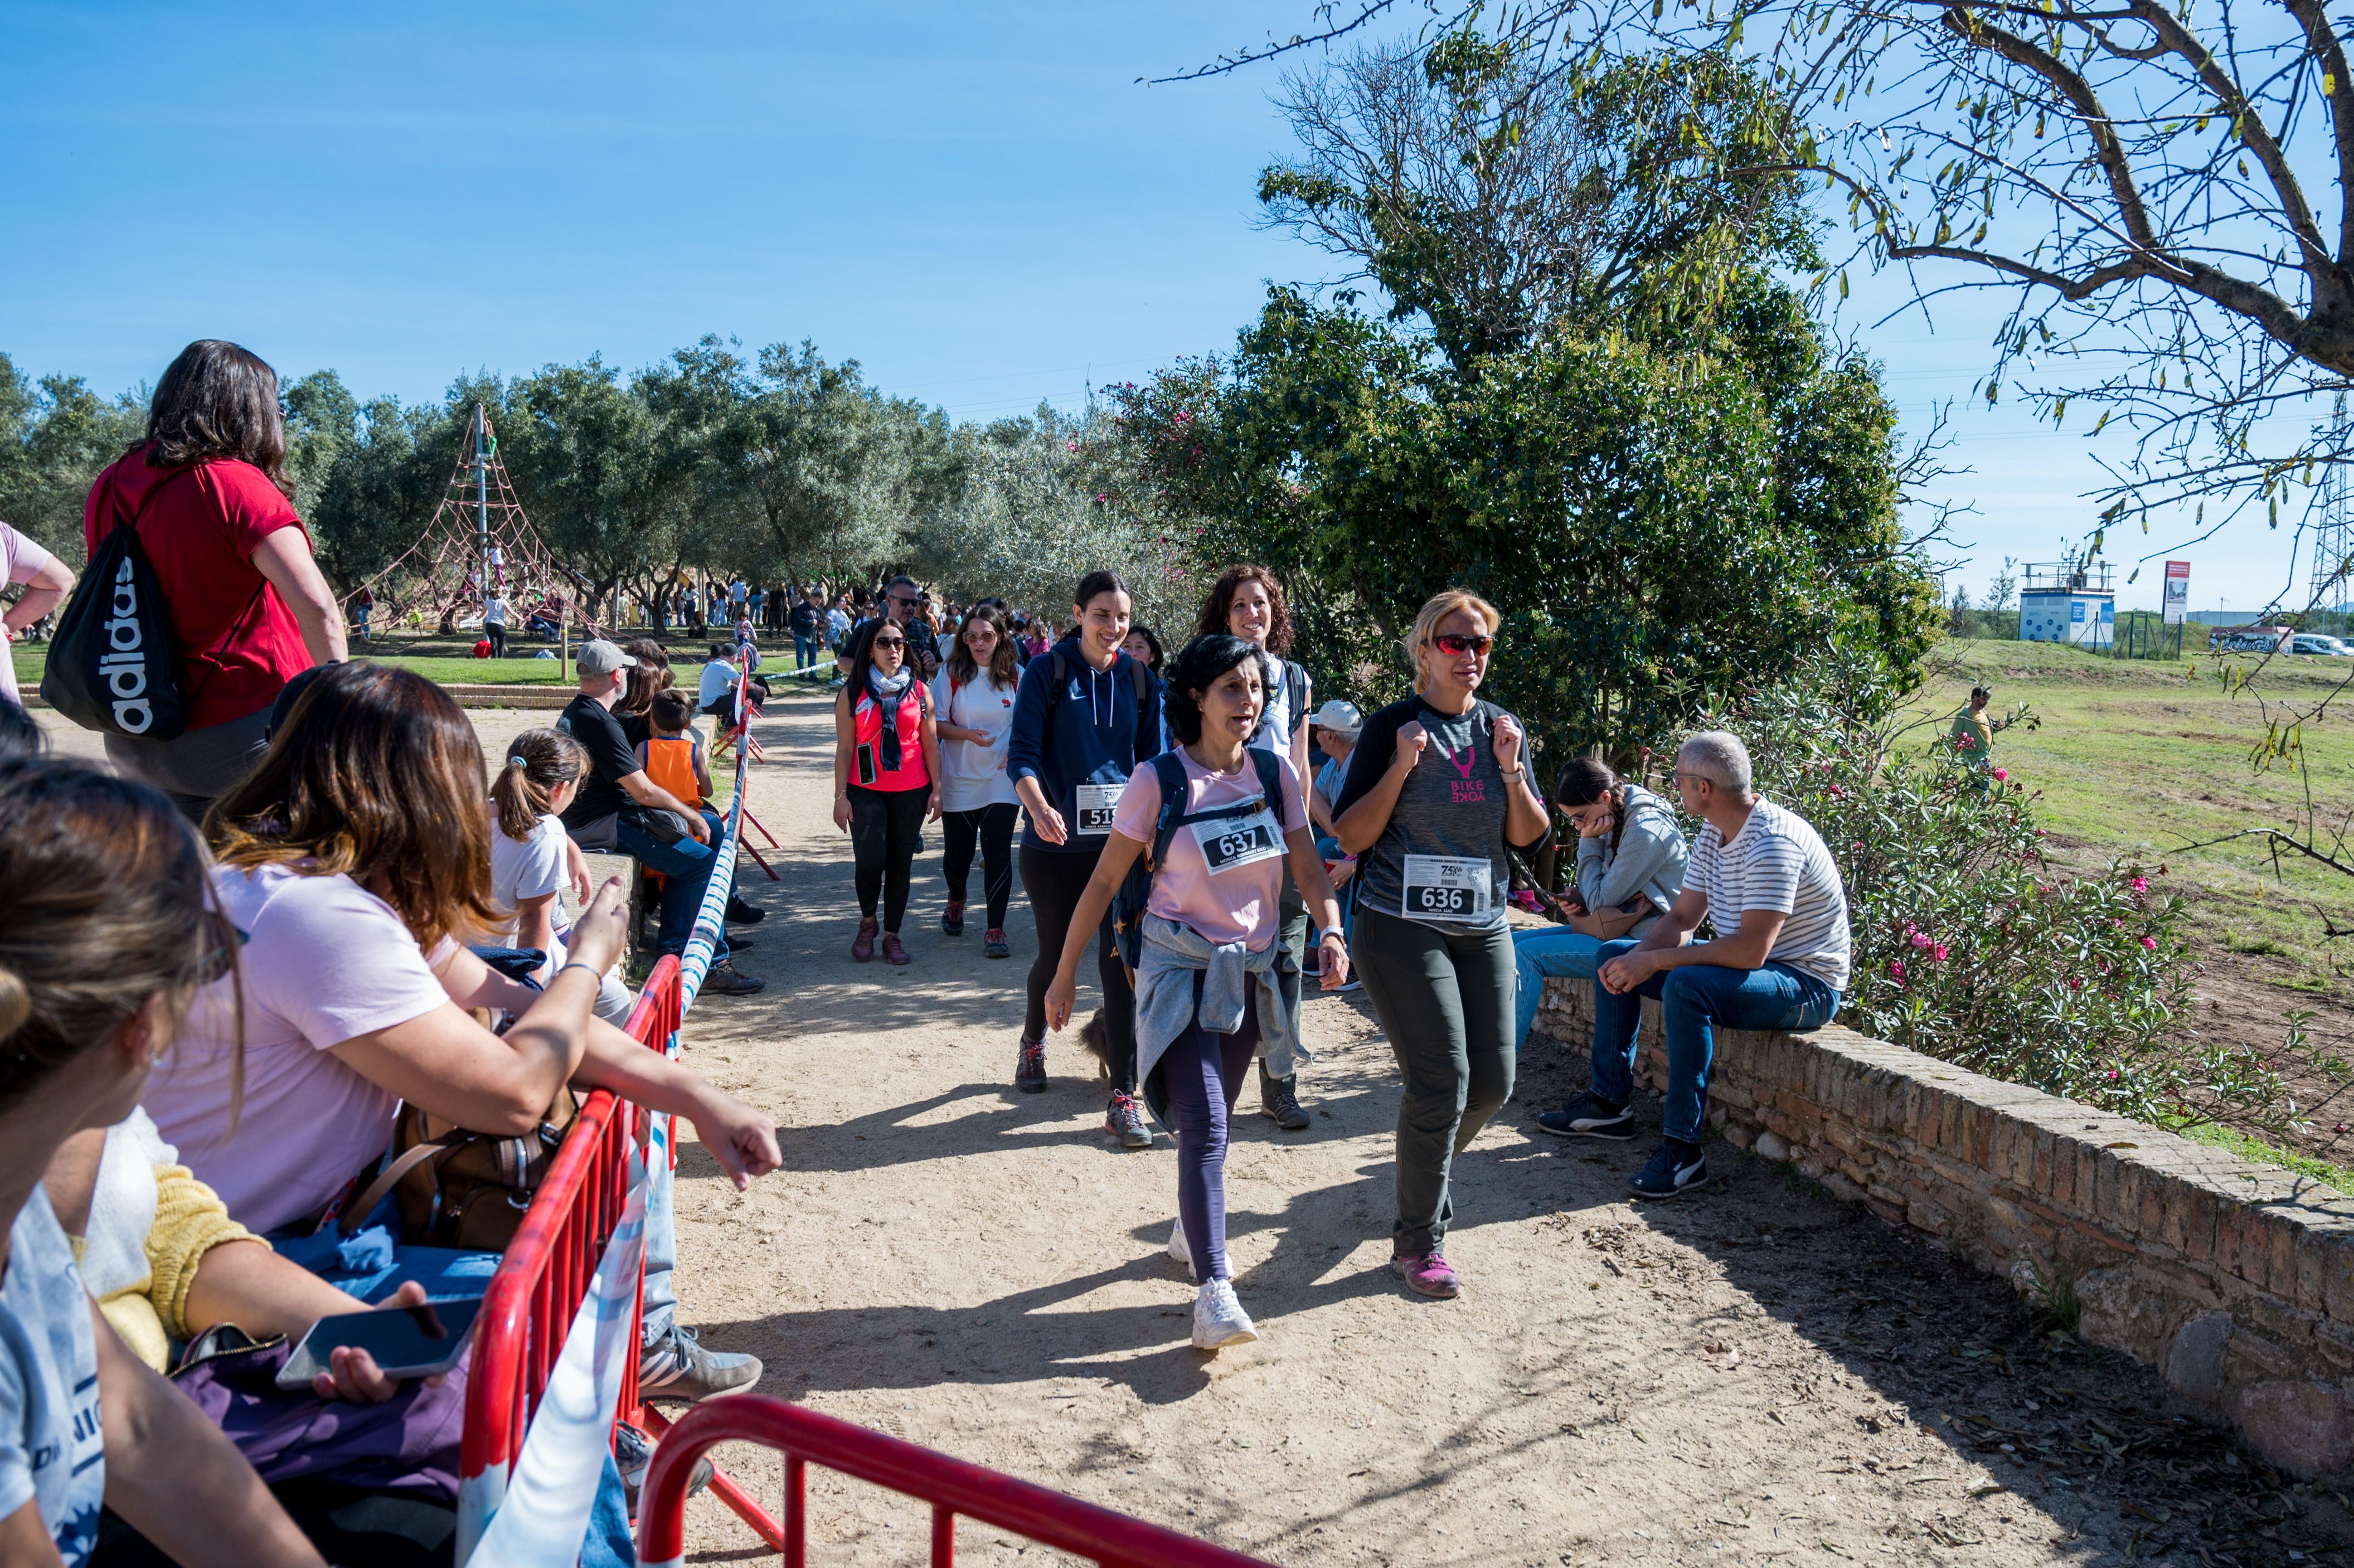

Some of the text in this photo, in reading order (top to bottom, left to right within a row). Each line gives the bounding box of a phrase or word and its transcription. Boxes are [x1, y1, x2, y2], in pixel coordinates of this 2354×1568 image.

[99, 556, 153, 734] adidas
[1451, 780, 1484, 792] BIKE
[1219, 829, 1256, 857] 637
[1421, 887, 1463, 909] 636
